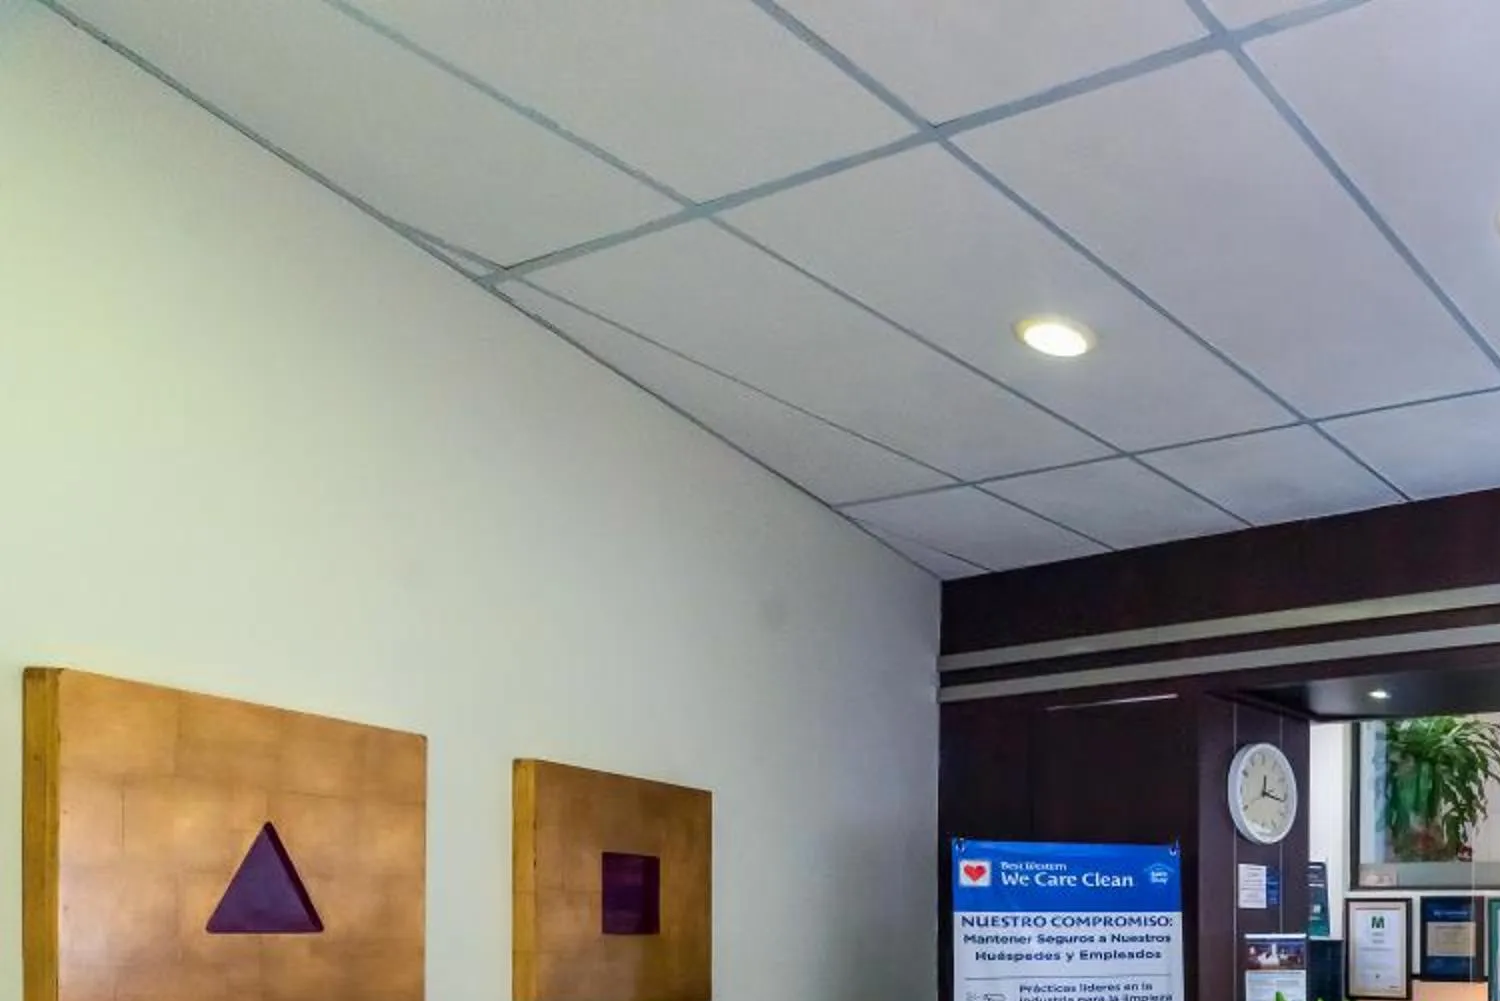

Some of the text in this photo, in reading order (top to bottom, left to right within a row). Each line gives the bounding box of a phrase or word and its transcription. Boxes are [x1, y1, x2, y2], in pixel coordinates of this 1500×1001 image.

[1001, 871, 1030, 886] We
[1034, 871, 1077, 887] Care
[1081, 871, 1134, 888] Clean
[961, 915, 1173, 928] NUESTRO COMPROMISO:
[963, 933, 1171, 945] Mantener Seguros a Nuestros
[1065, 952, 1074, 963] y
[1079, 950, 1162, 961] Empleados
[1123, 983, 1139, 991] en
